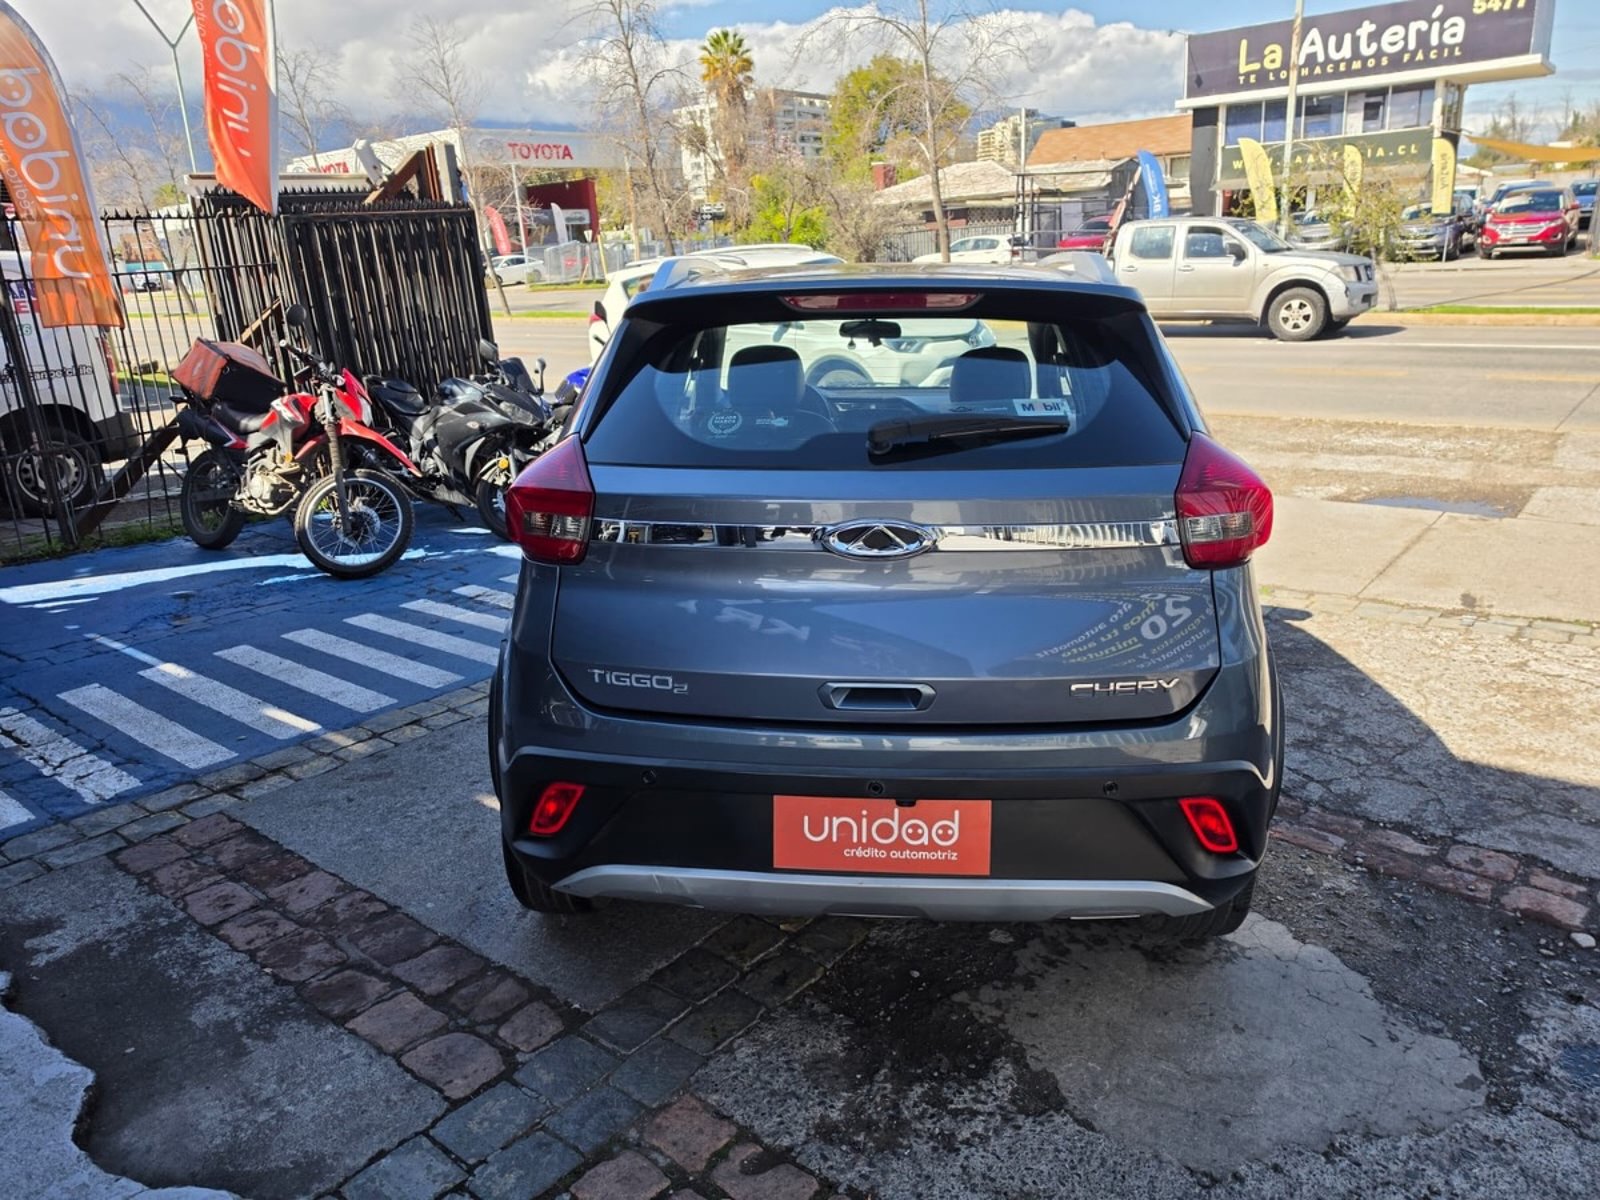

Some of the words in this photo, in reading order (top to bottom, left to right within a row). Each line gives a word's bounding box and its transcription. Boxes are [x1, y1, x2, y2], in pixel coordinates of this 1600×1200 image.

[1239, 38, 1283, 74] La
[1298, 4, 1466, 66] Autería
[1238, 74, 1257, 85] TE
[1269, 70, 1287, 81] LO
[1301, 56, 1389, 77] HACEMOS
[1403, 46, 1463, 63] FÁCIL
[508, 142, 574, 160] TOYOTA
[1069, 678, 1180, 697] CHERY
[803, 807, 960, 847] unidad
[843, 846, 888, 859] crédito
[889, 848, 959, 861] automotriz
